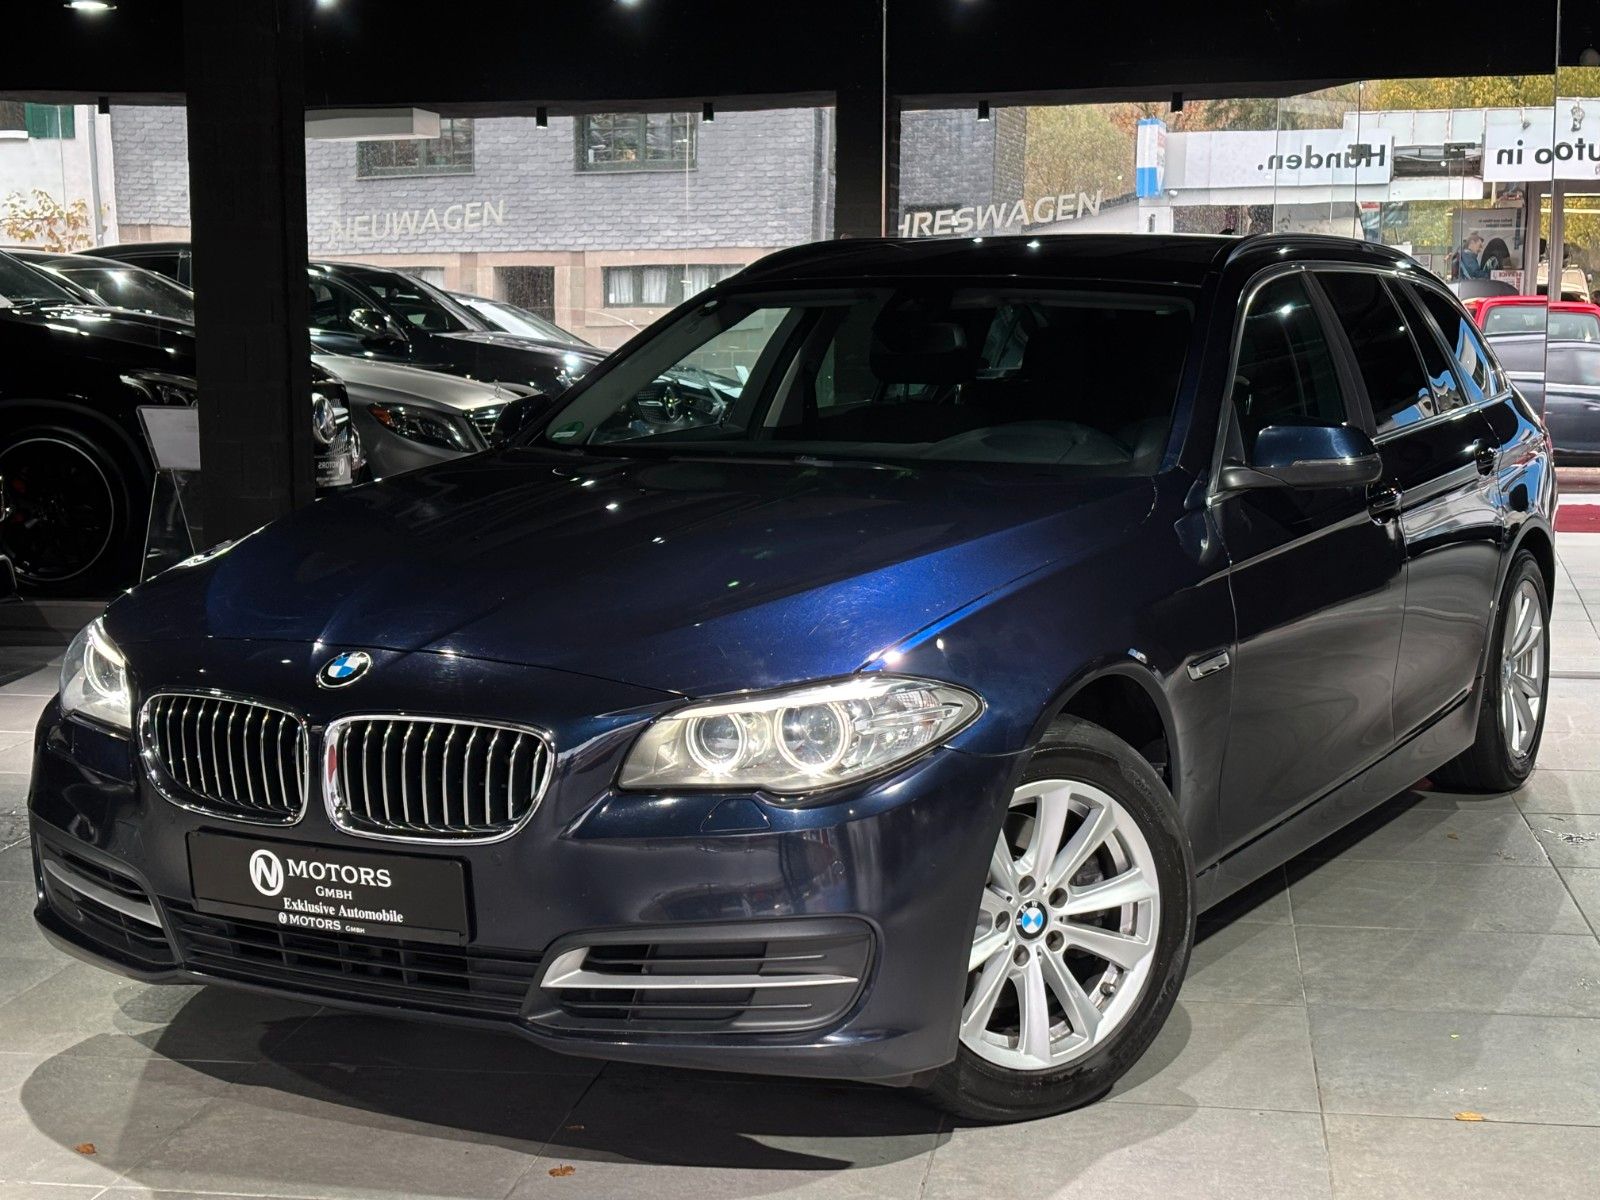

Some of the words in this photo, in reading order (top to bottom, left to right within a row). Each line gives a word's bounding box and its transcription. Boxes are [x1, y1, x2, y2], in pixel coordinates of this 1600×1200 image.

[330, 199, 504, 244] NEUWAGEN
[286, 858, 392, 888] MOTORS
[315, 885, 353, 900] GMBH
[283, 897, 336, 916] Exklusive
[338, 904, 403, 924] Automobile
[289, 914, 341, 931] MOTORS
